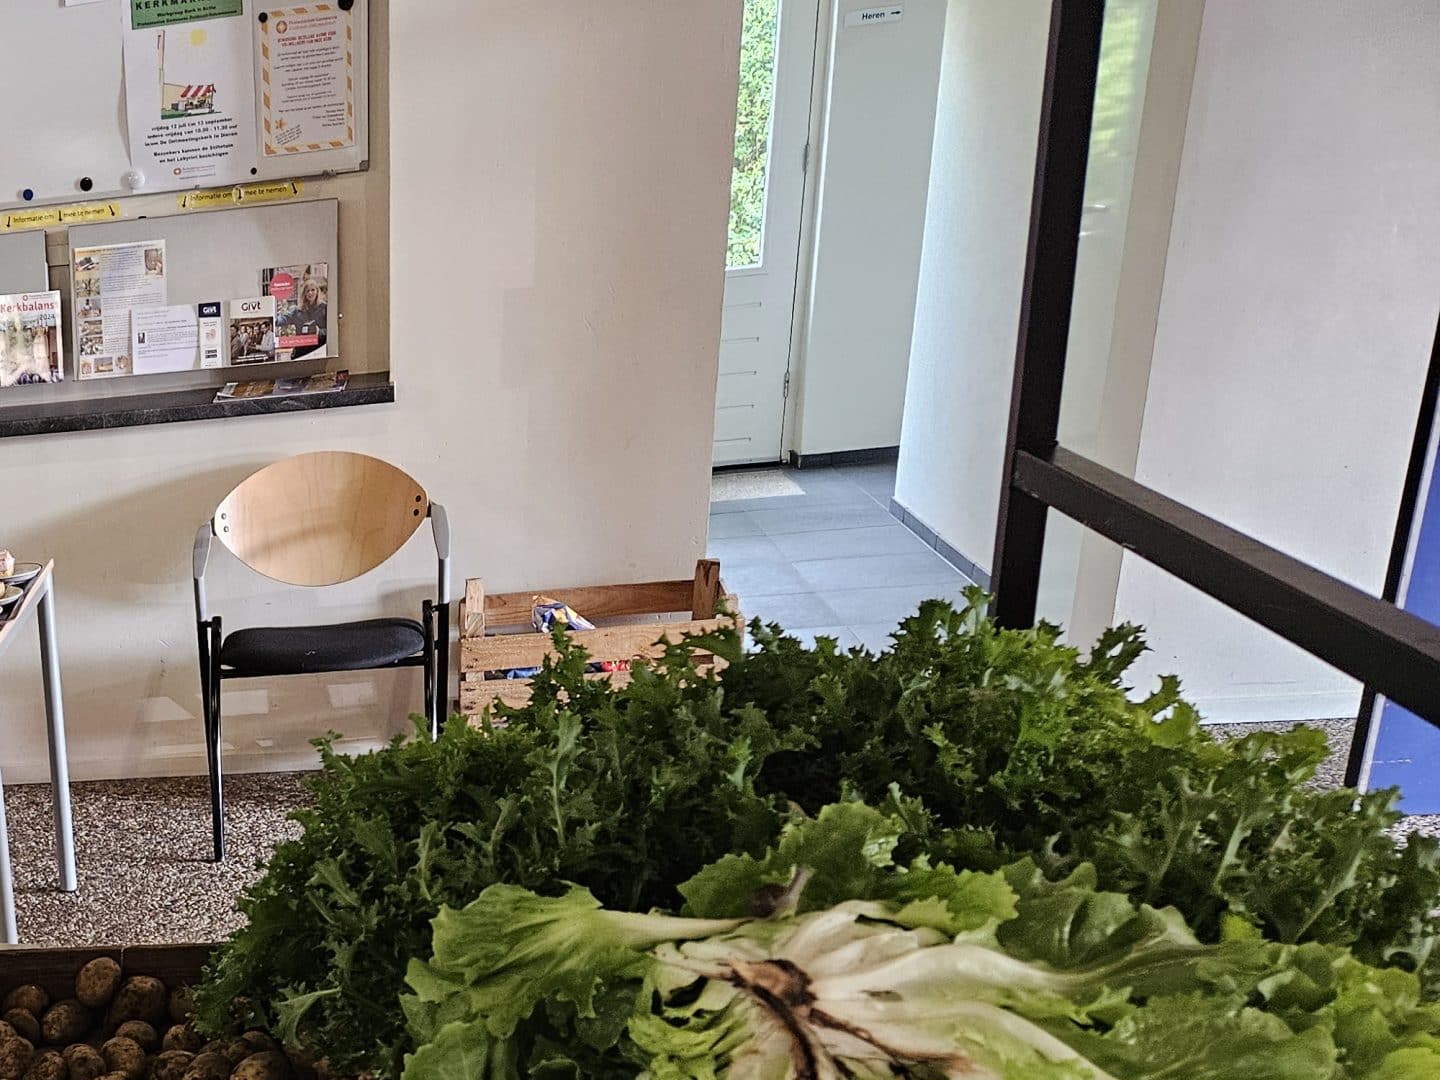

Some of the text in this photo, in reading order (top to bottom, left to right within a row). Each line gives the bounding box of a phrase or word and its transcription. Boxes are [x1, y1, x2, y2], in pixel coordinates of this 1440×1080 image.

[862, 12, 885, 20] Heren
[190, 192, 221, 201] Informatie
[222, 191, 233, 199] om
[265, 187, 287, 195] nemen
[13, 214, 44, 224] Informatie
[85, 208, 105, 216] nemen
[0, 301, 55, 313] Kerkbalans
[202, 306, 217, 314] Givt
[241, 301, 262, 312] Givt
